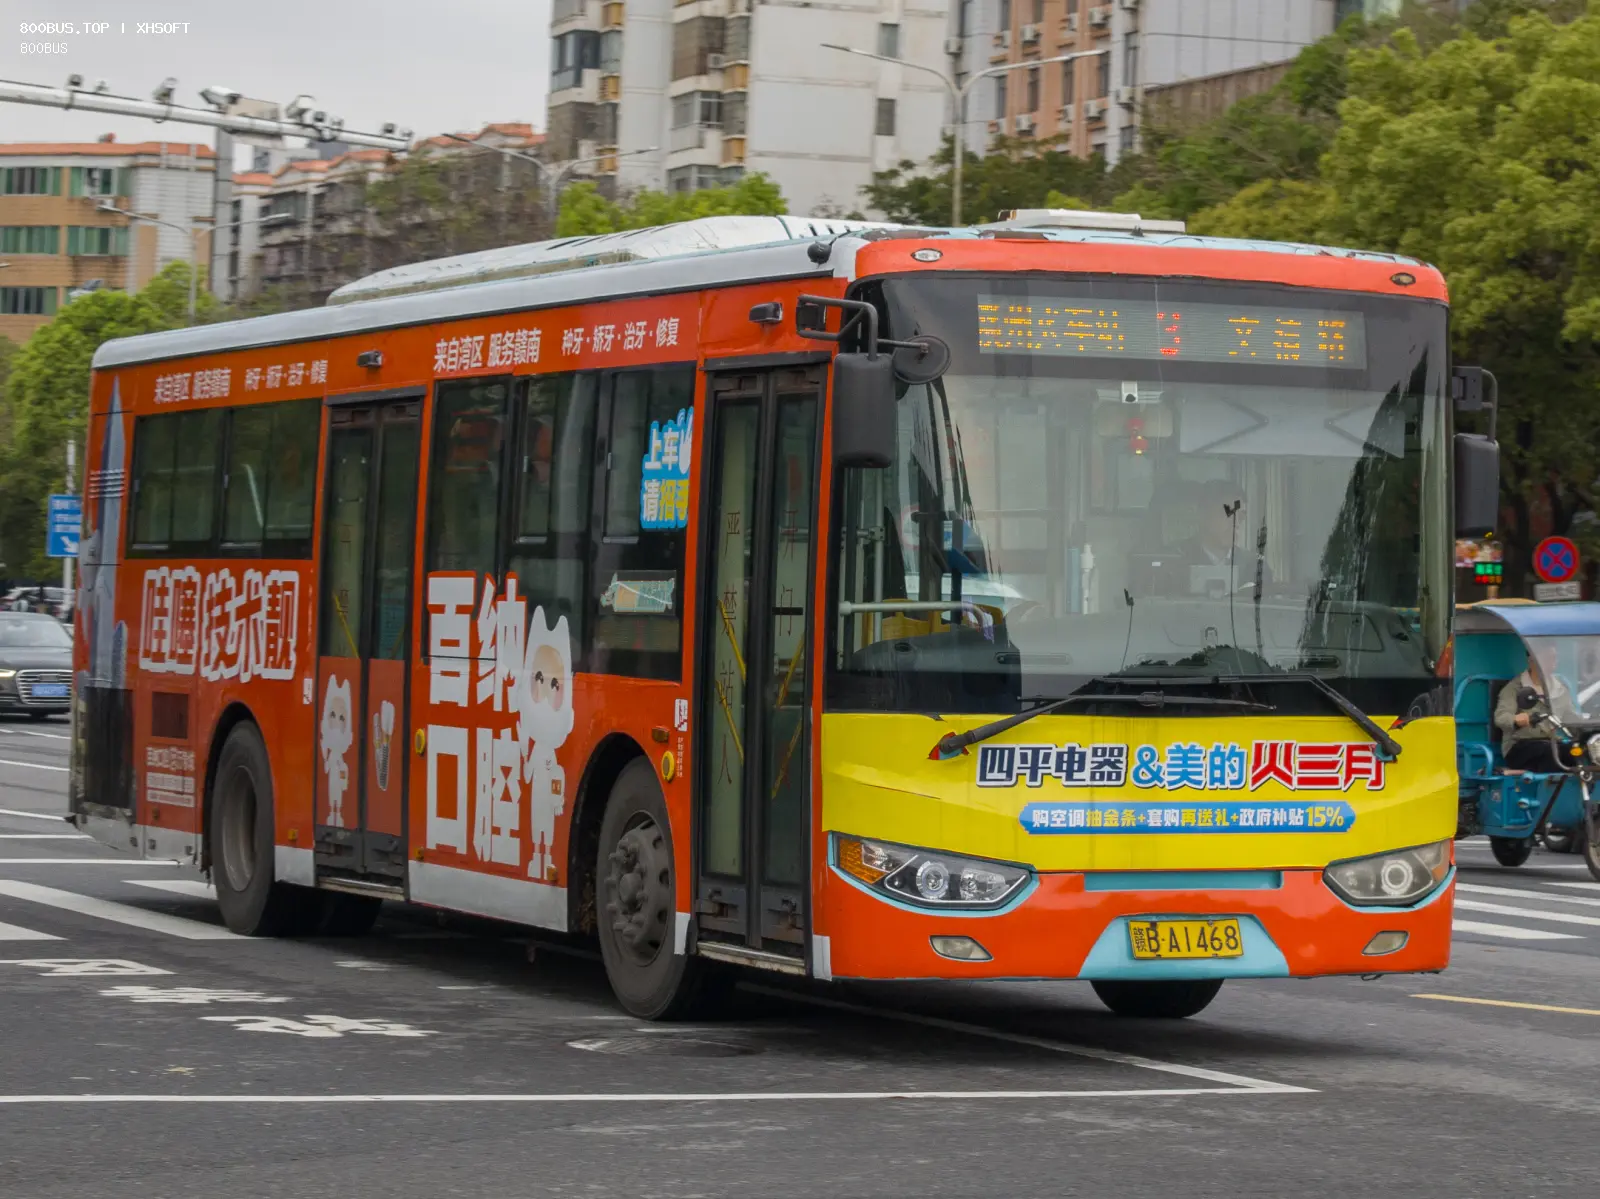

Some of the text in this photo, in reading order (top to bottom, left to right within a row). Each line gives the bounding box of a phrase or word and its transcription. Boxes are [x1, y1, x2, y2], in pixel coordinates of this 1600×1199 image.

[433, 335, 485, 373] 来自湾区
[487, 327, 542, 367] 服务赣南
[1157, 312, 1180, 355] 3
[643, 426, 680, 472] 上车
[427, 571, 527, 713] 百纳
[425, 724, 522, 867] 口腔
